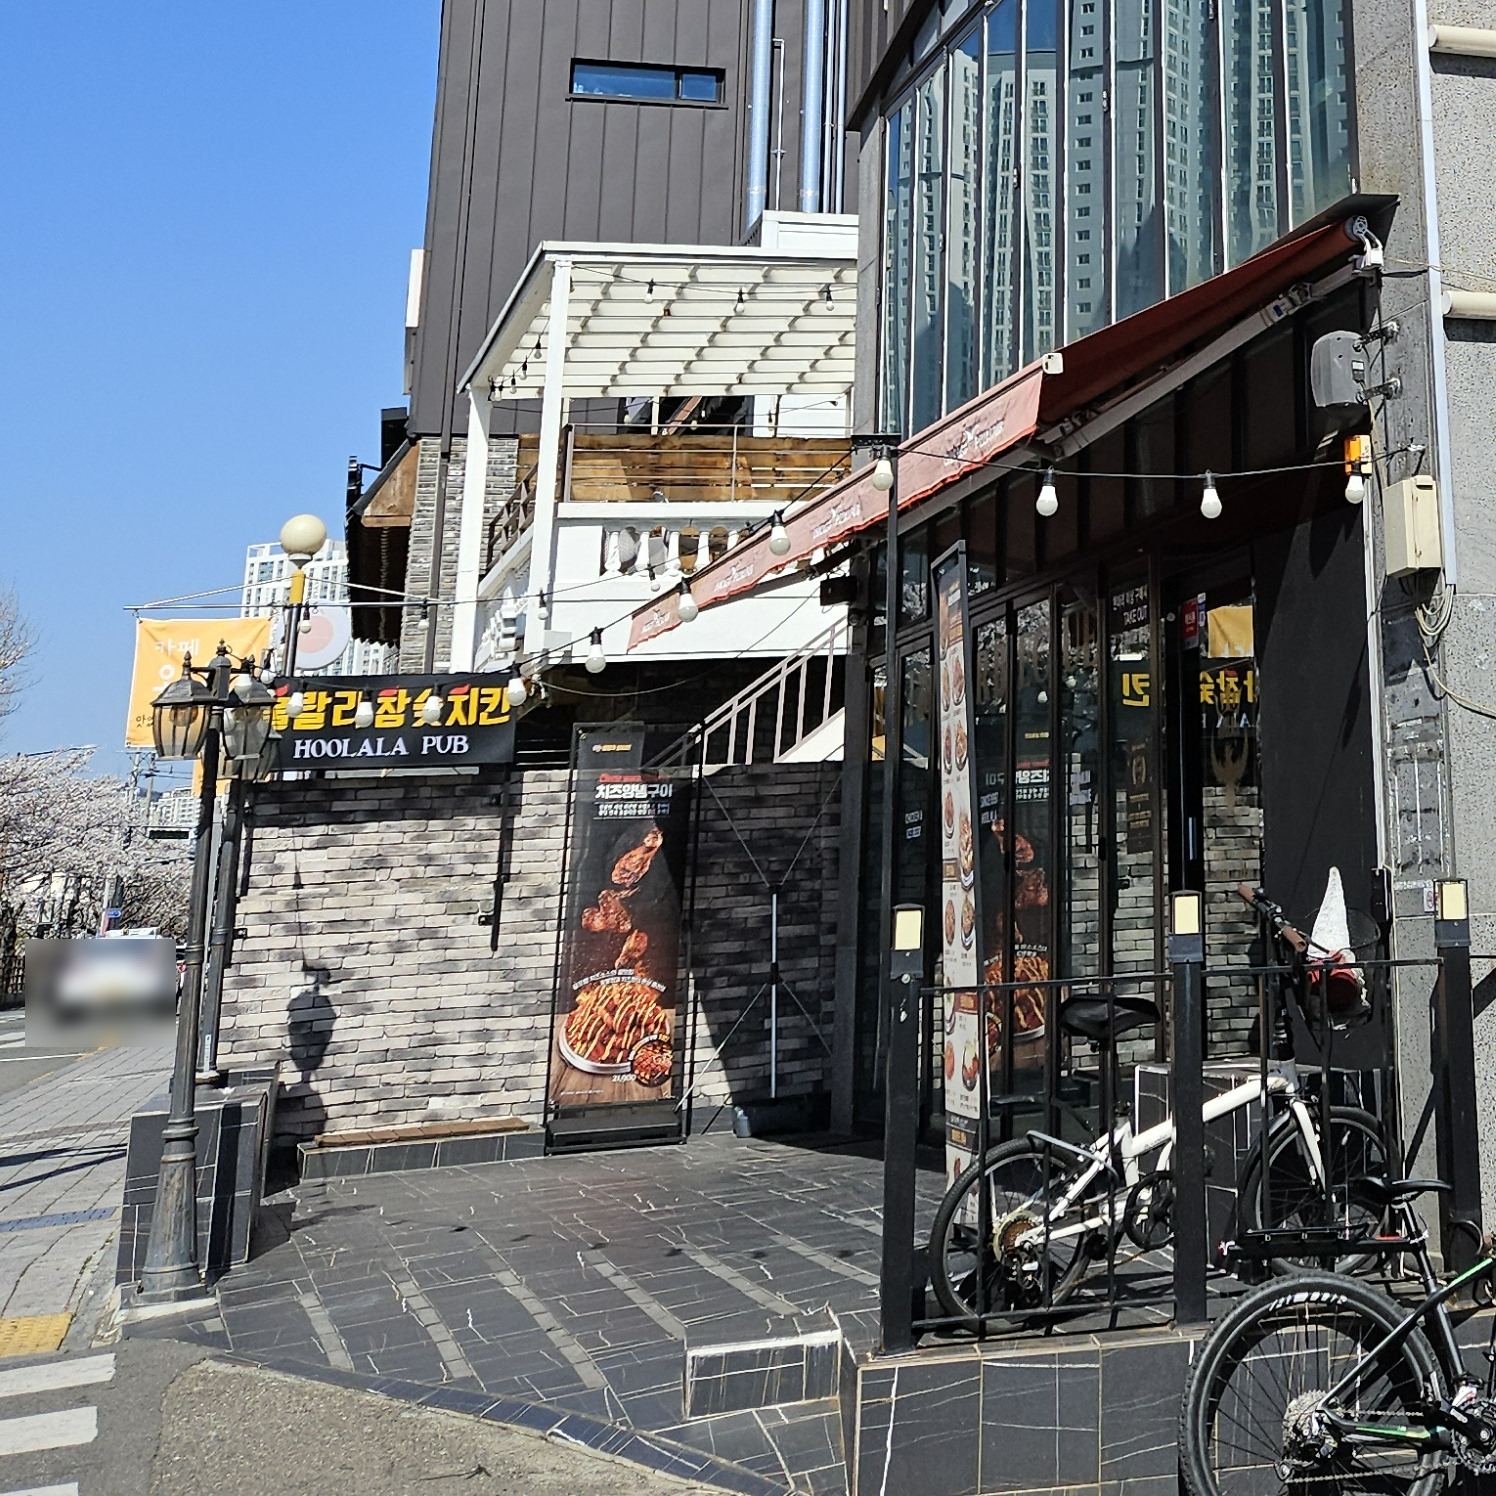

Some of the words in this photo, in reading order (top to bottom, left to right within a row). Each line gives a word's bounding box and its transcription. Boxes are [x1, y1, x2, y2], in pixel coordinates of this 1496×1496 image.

[293, 735, 409, 760] HOOLALA
[421, 734, 470, 755] PUB
[595, 783, 673, 800] 치즈양념구이
